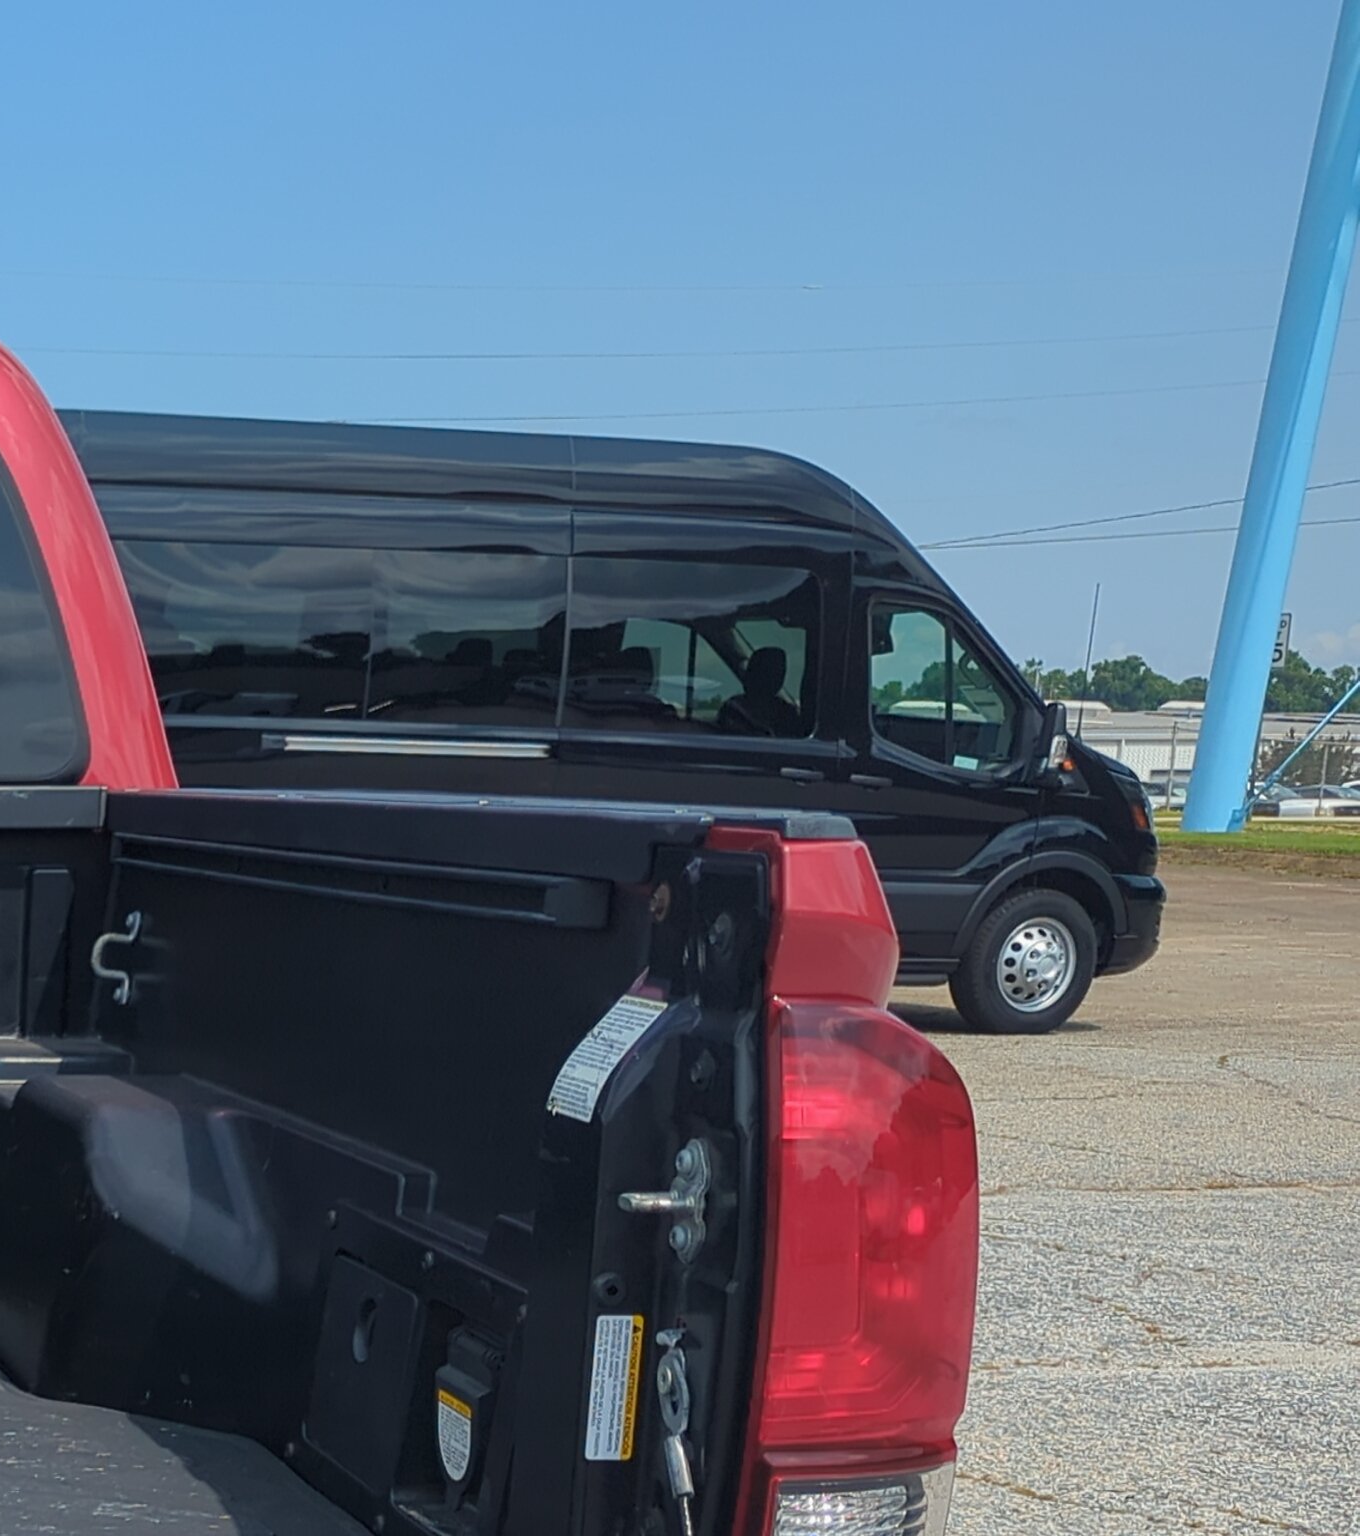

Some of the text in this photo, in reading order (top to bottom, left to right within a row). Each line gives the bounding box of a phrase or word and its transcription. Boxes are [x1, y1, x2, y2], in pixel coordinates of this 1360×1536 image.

[1272, 643, 1284, 663] 5
[622, 1334, 641, 1456] CAUTION ATTENTION ATENCIÓN
